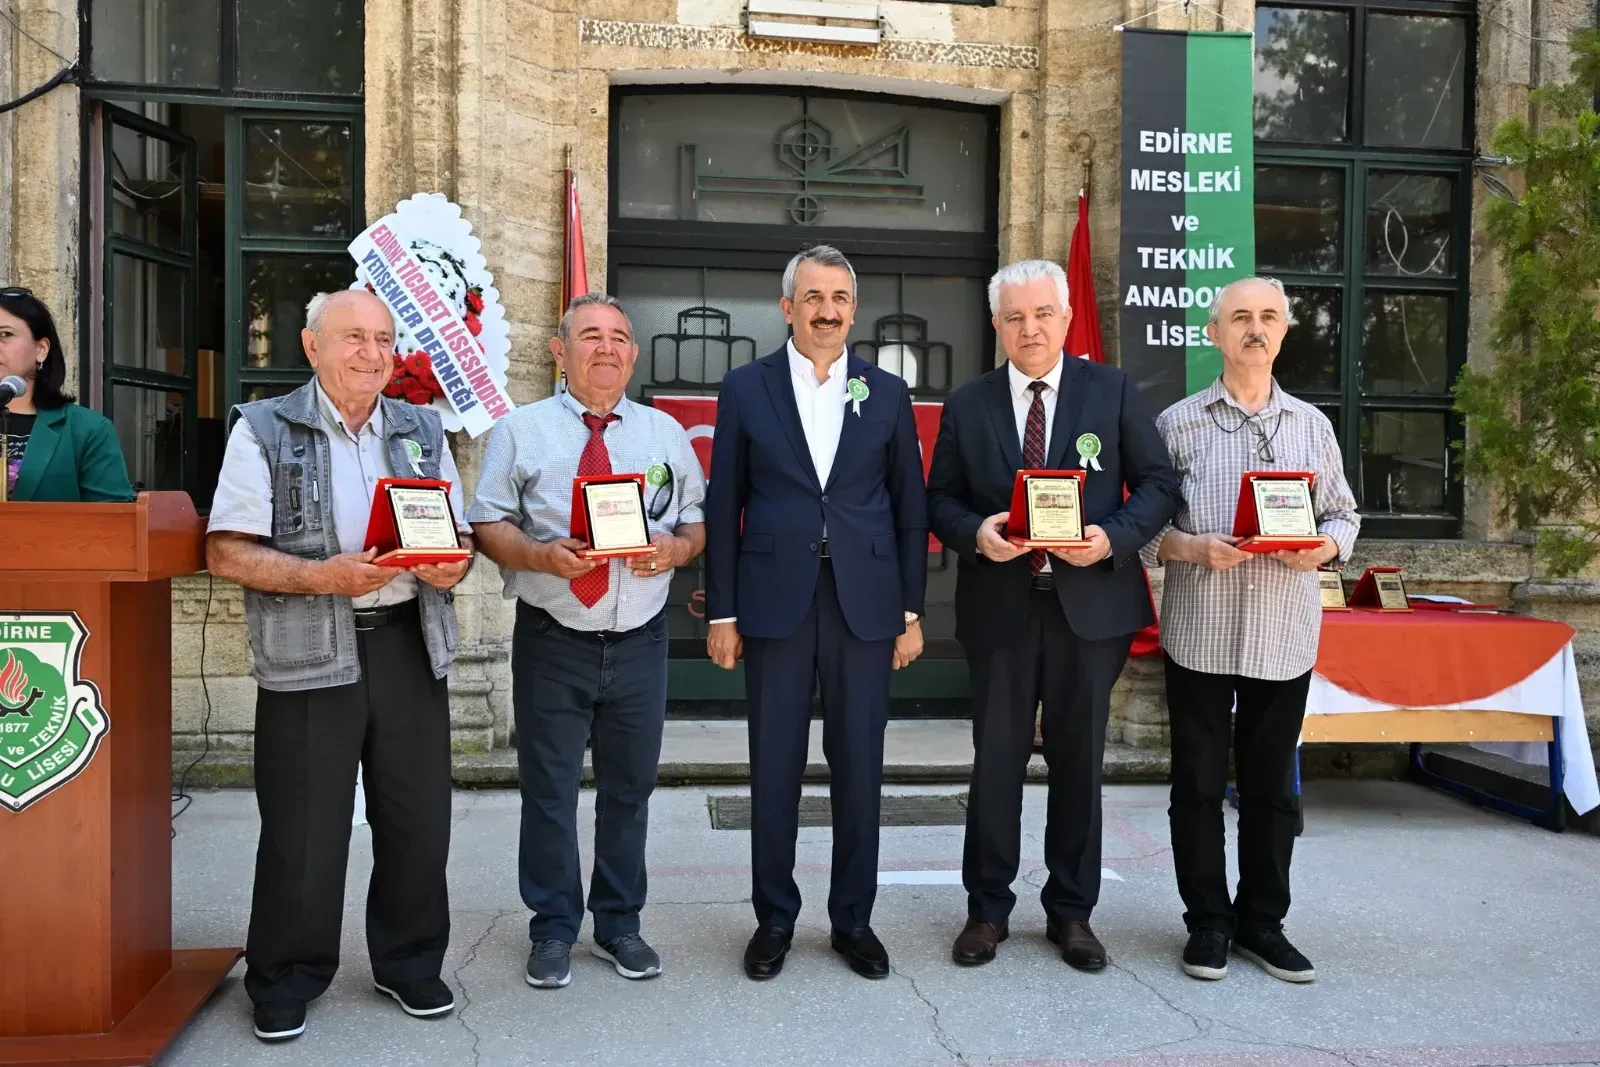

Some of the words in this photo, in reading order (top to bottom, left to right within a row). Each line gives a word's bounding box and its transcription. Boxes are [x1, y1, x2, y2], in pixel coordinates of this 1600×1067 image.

[1139, 127, 1233, 154] EDİRNE
[1130, 165, 1242, 193] MESLEKİ
[1171, 215, 1199, 232] ve
[1137, 243, 1235, 270] TEKNİK
[1124, 285, 1222, 308] ANADO
[361, 248, 424, 329] YETİŞENLER
[414, 326, 478, 415] DERNEĞİ
[369, 223, 408, 268] EDİRNE
[396, 258, 452, 322] TİCARET
[438, 320, 511, 421] LİSESİNDEN
[0, 621, 52, 639] İRNE
[7, 745, 25, 756] ve
[29, 694, 67, 748] TEKNİK
[26, 738, 79, 781] LİSESİ
